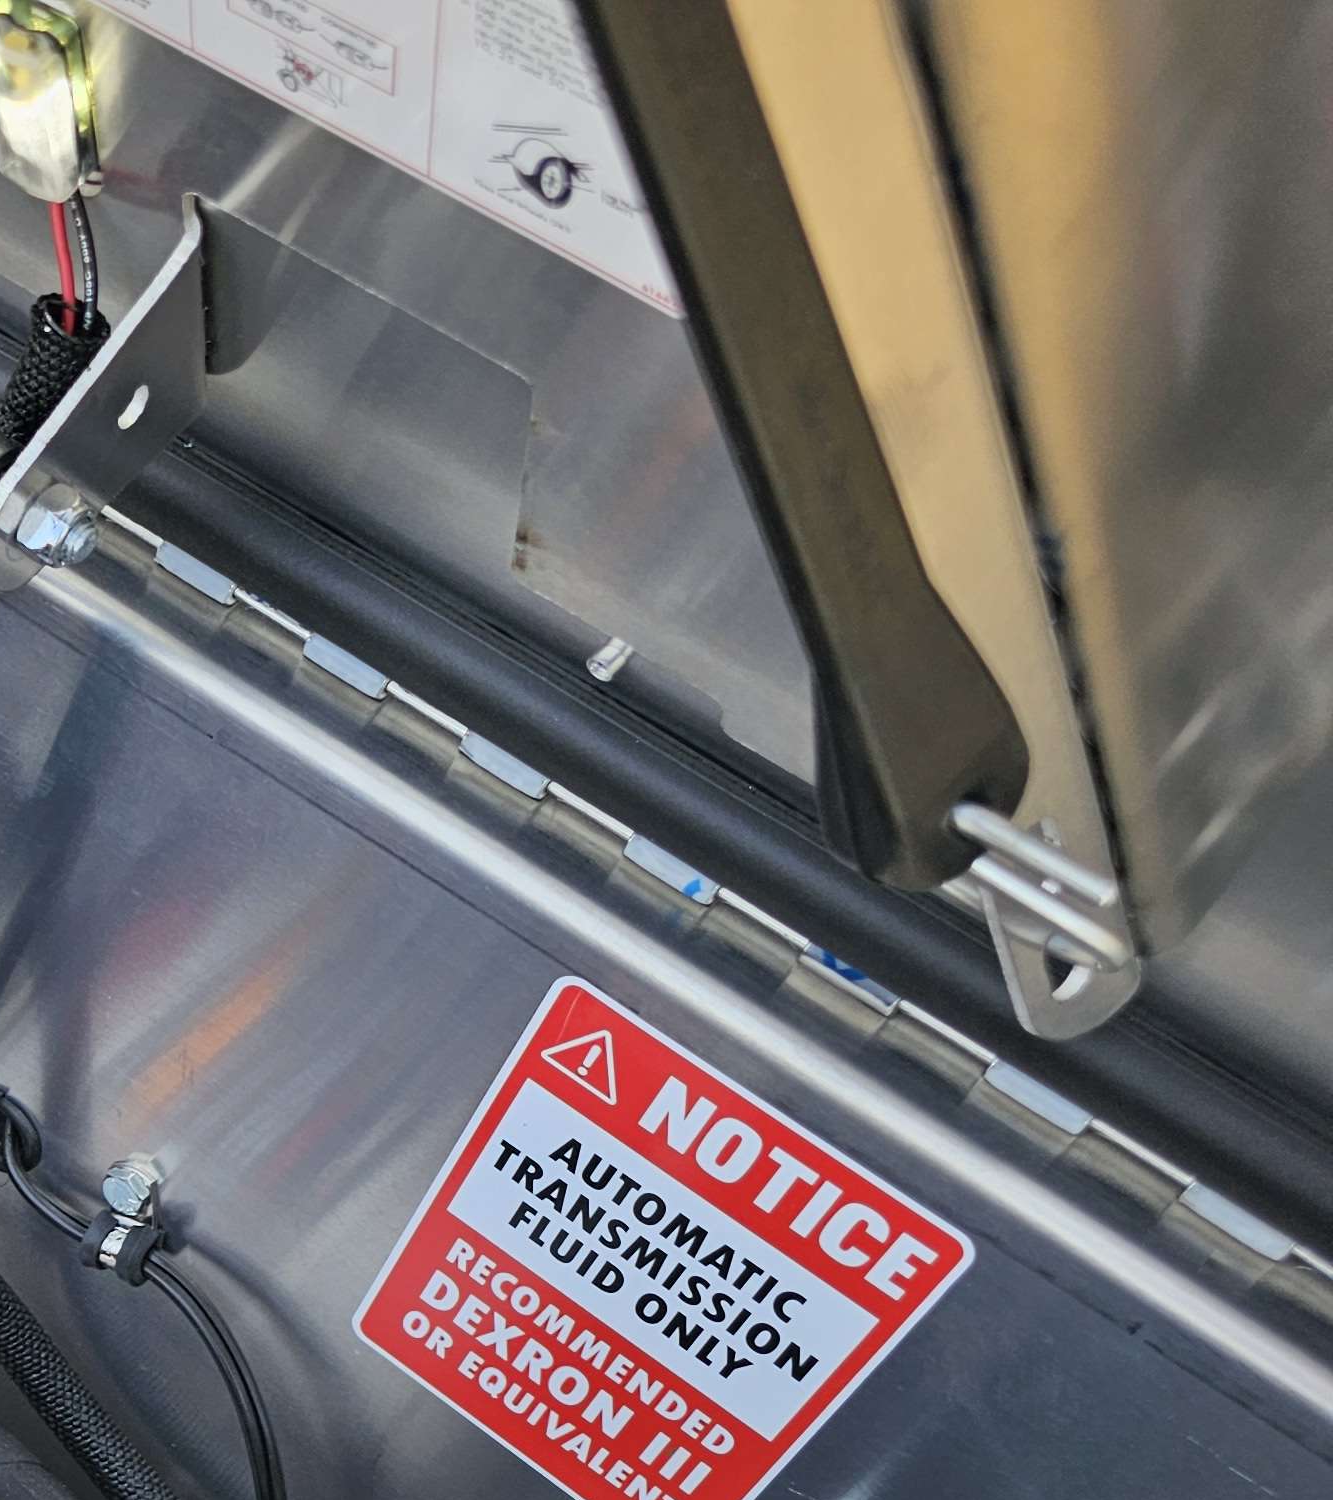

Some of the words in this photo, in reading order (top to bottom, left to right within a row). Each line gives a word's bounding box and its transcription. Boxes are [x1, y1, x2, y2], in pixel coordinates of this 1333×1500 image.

[487, 1139, 820, 1383] TRANSMISSION
[506, 1199, 631, 1299] FLUID
[629, 1288, 754, 1386] ONLY
[546, 1131, 809, 1325] AUTOMATIC
[634, 1073, 943, 1302] NOTICE
[398, 1305, 457, 1360] OR
[417, 1267, 635, 1442] DEXRON
[637, 1430, 713, 1497] III
[444, 1236, 740, 1461] RECOMMENDED
